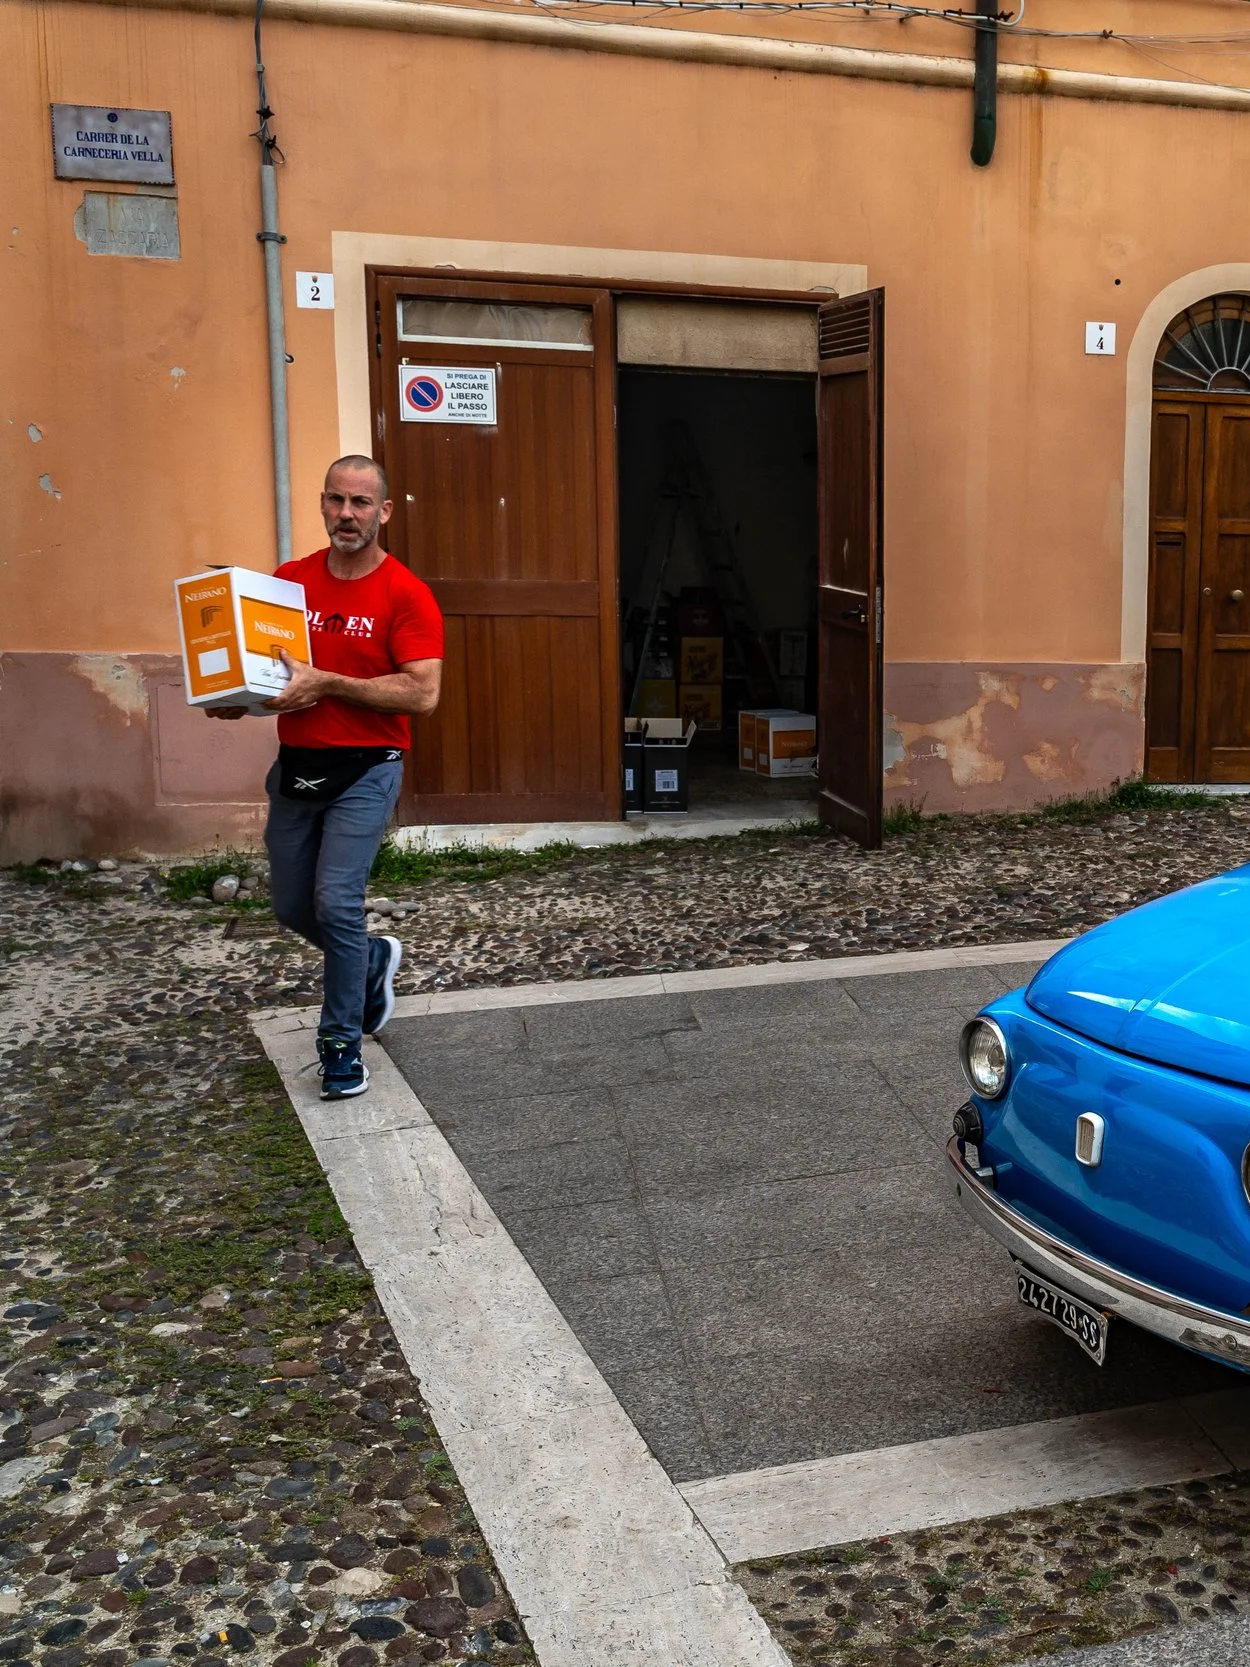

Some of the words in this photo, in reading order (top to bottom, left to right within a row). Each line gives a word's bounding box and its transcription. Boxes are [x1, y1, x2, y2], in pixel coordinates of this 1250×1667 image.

[76, 130, 118, 144] CARRER
[120, 134, 134, 145] DE
[136, 135, 150, 146] LA
[63, 146, 129, 160] CARNECERIA
[131, 151, 164, 163] VELLA
[310, 285, 321, 301] 2
[1096, 336, 1105, 350] 4
[444, 382, 489, 391] LASCIARE
[450, 392, 484, 401] LIBERO
[447, 402, 456, 410] IL
[458, 403, 488, 411] PASSO
[343, 629, 372, 638] CLUB
